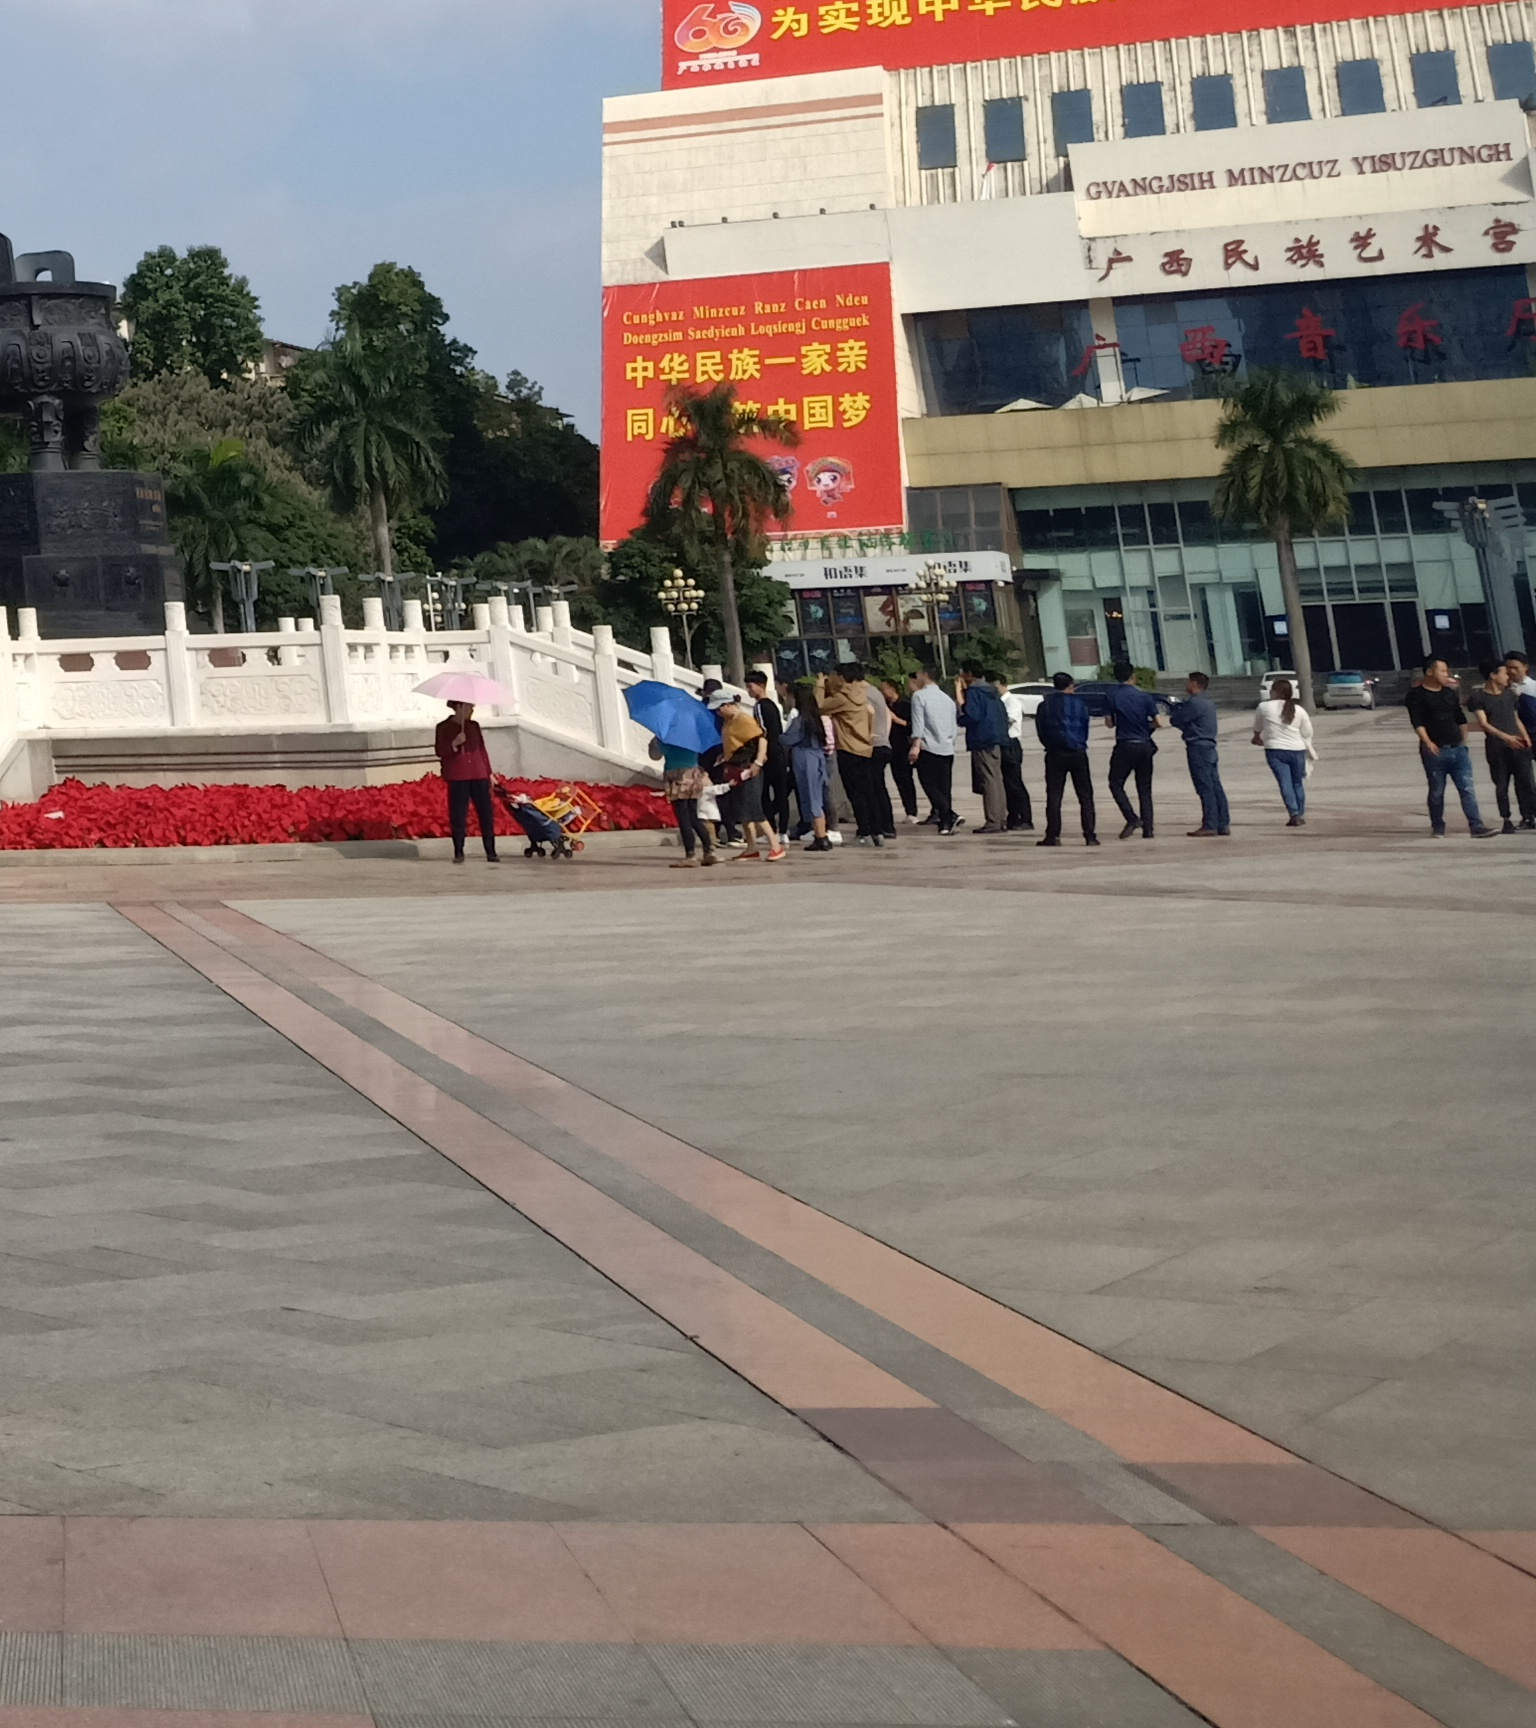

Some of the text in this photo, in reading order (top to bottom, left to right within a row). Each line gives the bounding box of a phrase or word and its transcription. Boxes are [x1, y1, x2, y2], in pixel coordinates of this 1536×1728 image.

[1086, 142, 1514, 201] GVANGJSIH MINZCUZ YISUZGUNGH
[1098, 217, 1521, 283] 广西民族艺术宫
[622, 293, 869, 326] Cunghvaz Minzcuz Ranz Caen Ndeu
[623, 313, 870, 347] Doengzsim Saedyienh Loqsiengj Cungguek
[625, 338, 869, 389] 中华民族一家亲
